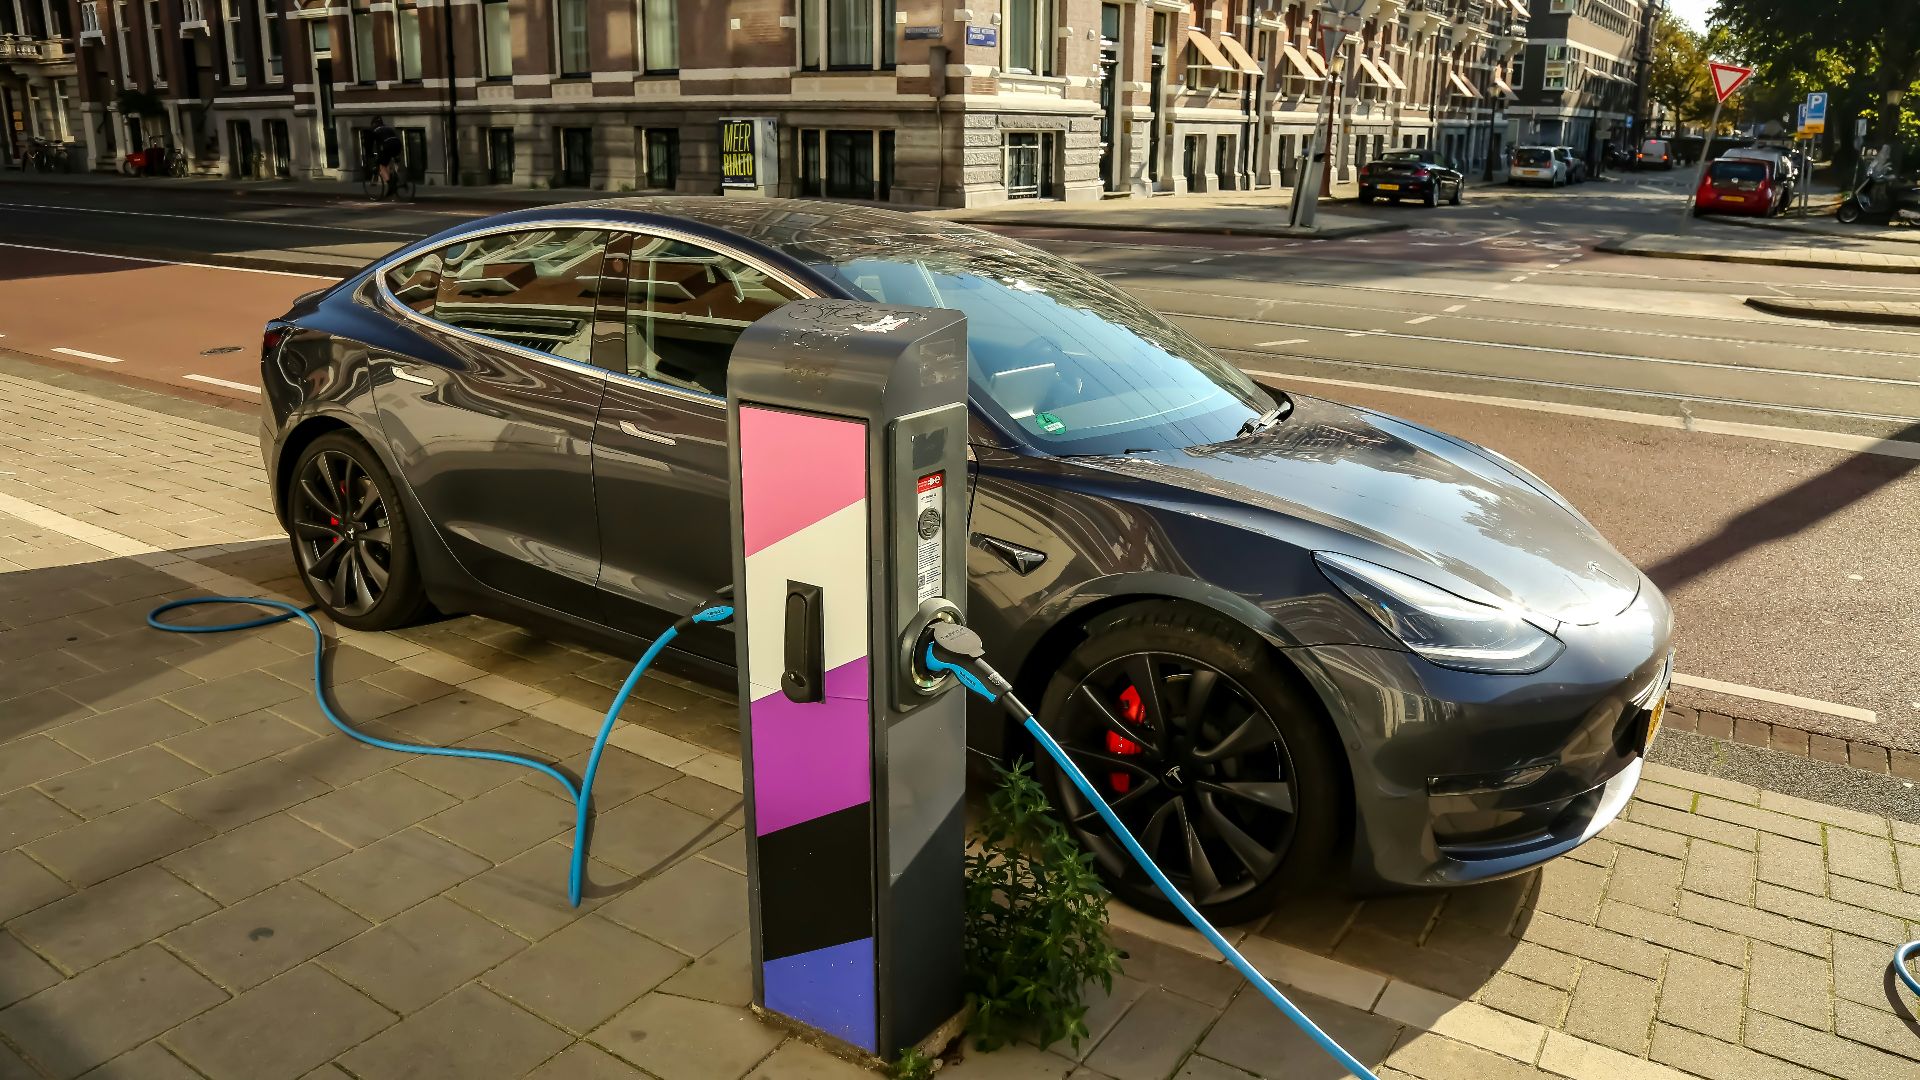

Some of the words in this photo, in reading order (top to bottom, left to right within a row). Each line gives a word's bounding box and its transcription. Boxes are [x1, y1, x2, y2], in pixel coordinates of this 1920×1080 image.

[1810, 95, 1823, 109] P
[723, 123, 751, 152] MEER
[723, 153, 753, 176] RIALTO
